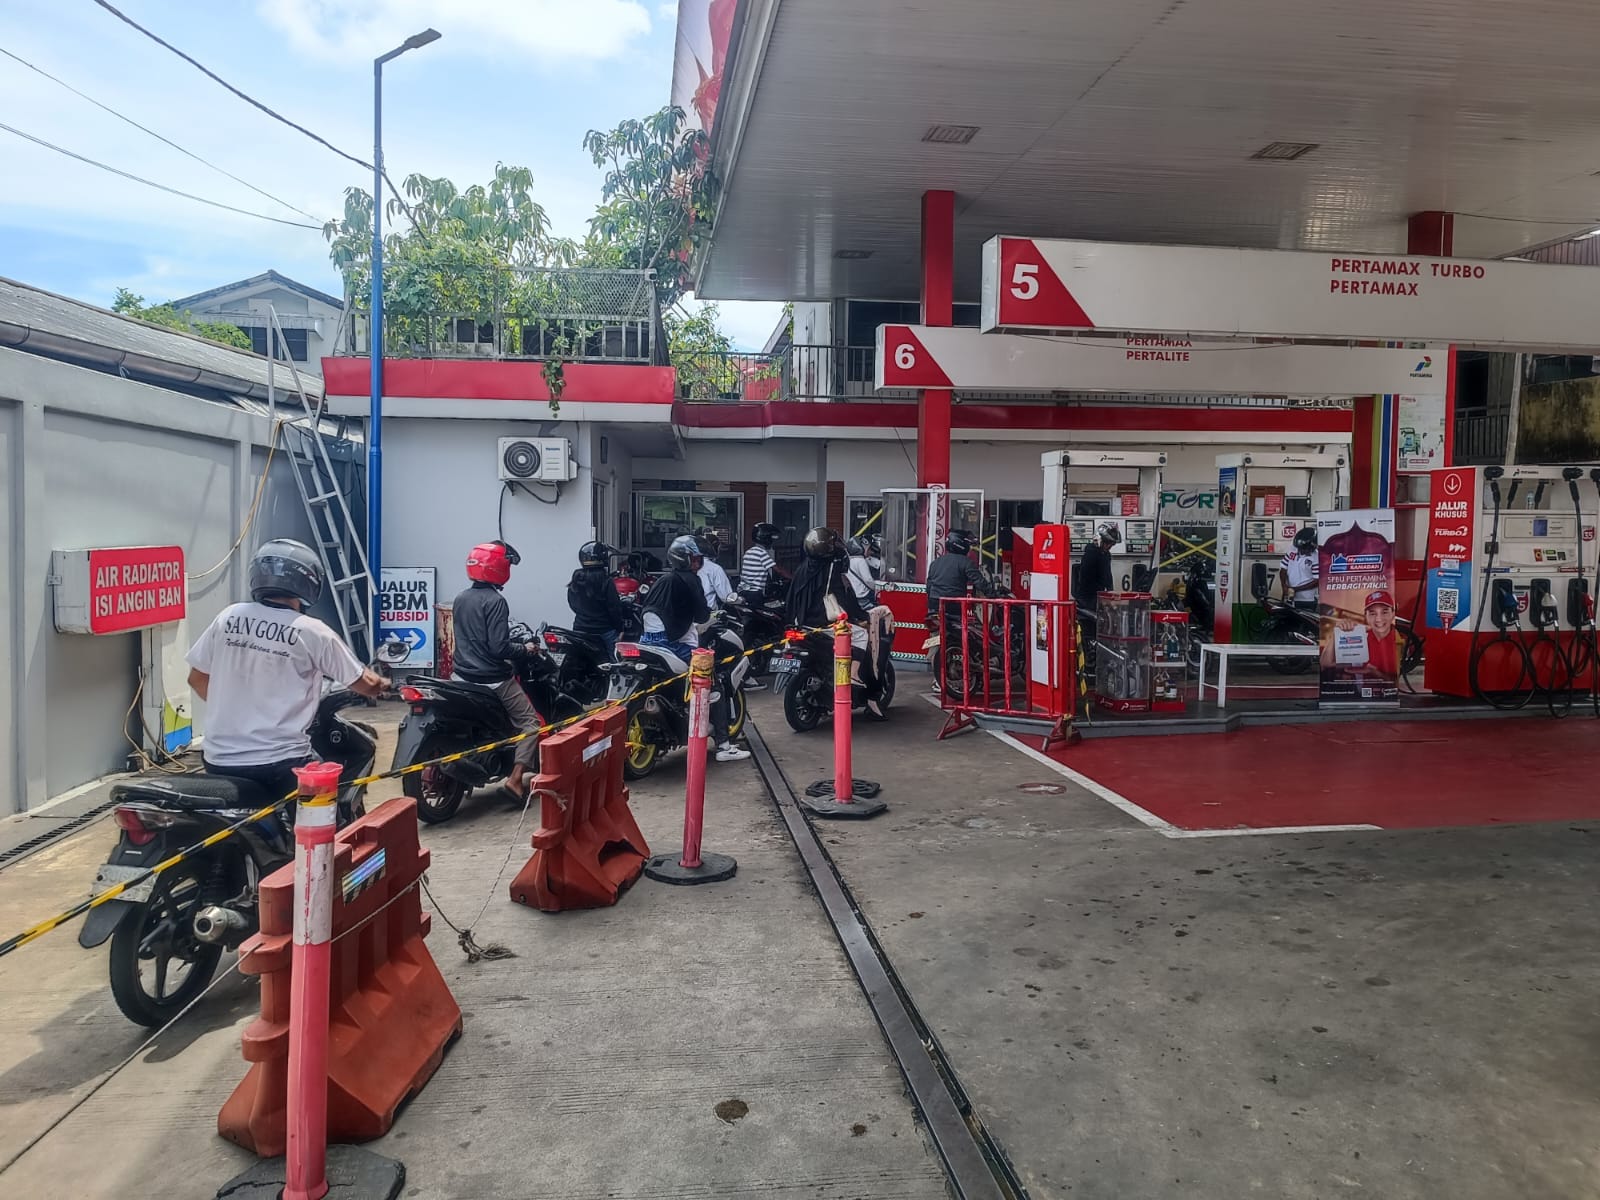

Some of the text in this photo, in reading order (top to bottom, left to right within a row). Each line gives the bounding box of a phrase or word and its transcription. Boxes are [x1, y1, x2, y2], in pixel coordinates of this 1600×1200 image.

[1331, 258, 1485, 279] PERTAMAX TURBO
[1010, 263, 1040, 300] 5
[1330, 279, 1419, 297] PERTAMAX
[1126, 337, 1192, 347] PERTAMAX
[894, 343, 916, 370] 6
[1126, 350, 1190, 361] PERTALITE
[1161, 490, 1218, 509] POR
[1435, 501, 1468, 511] JALUR
[1435, 510, 1468, 518] KHUSUS
[1434, 529, 1463, 537] TURBO
[96, 561, 180, 589] AIR RADIATOR
[1122, 574, 1130, 591] 6
[1267, 574, 1275, 590] 7
[380, 581, 428, 592] JALUR
[95, 586, 181, 617] ISI ANGIN BAN
[380, 593, 428, 610] BBM
[380, 611, 429, 621] SUBSIDI
[225, 615, 302, 646] SAN GOKU
